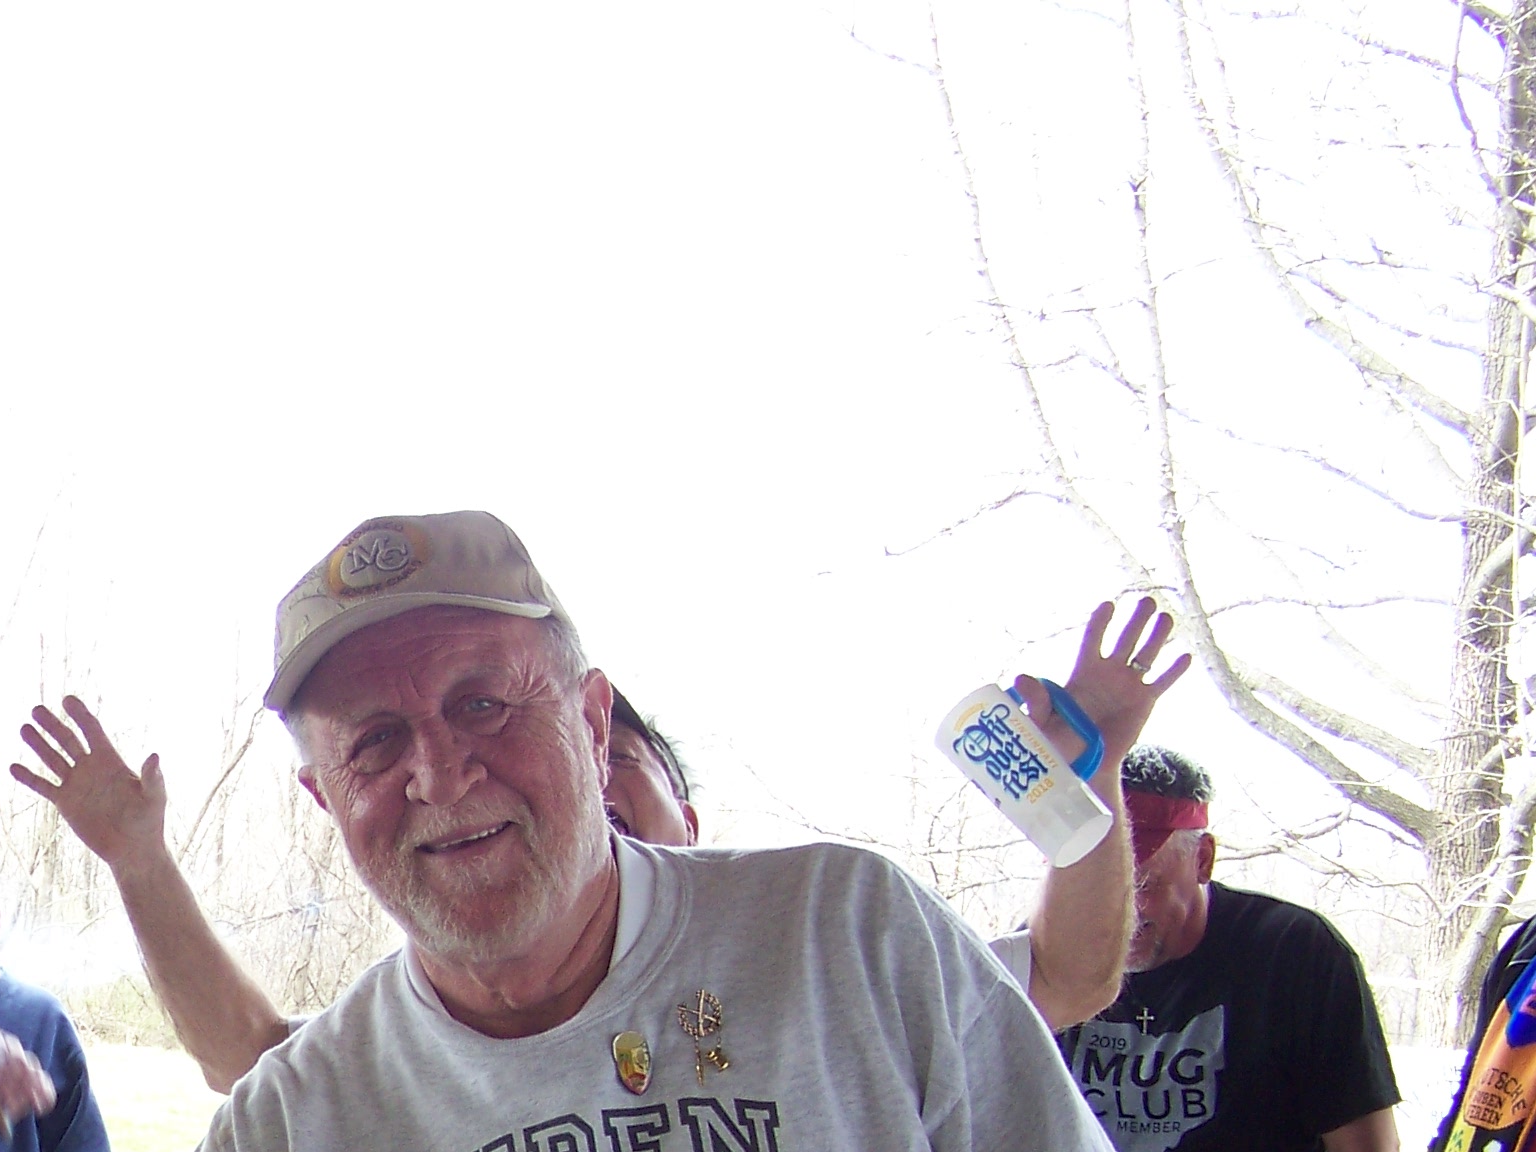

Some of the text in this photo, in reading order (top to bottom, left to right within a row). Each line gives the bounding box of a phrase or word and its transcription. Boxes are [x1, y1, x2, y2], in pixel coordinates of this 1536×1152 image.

[1027, 778, 1055, 805] 2018
[1088, 1034, 1127, 1049] 2019
[1081, 1048, 1205, 1087] MUG
[1082, 1088, 1207, 1120] CLUB
[1116, 1121, 1181, 1133] MEMBER
